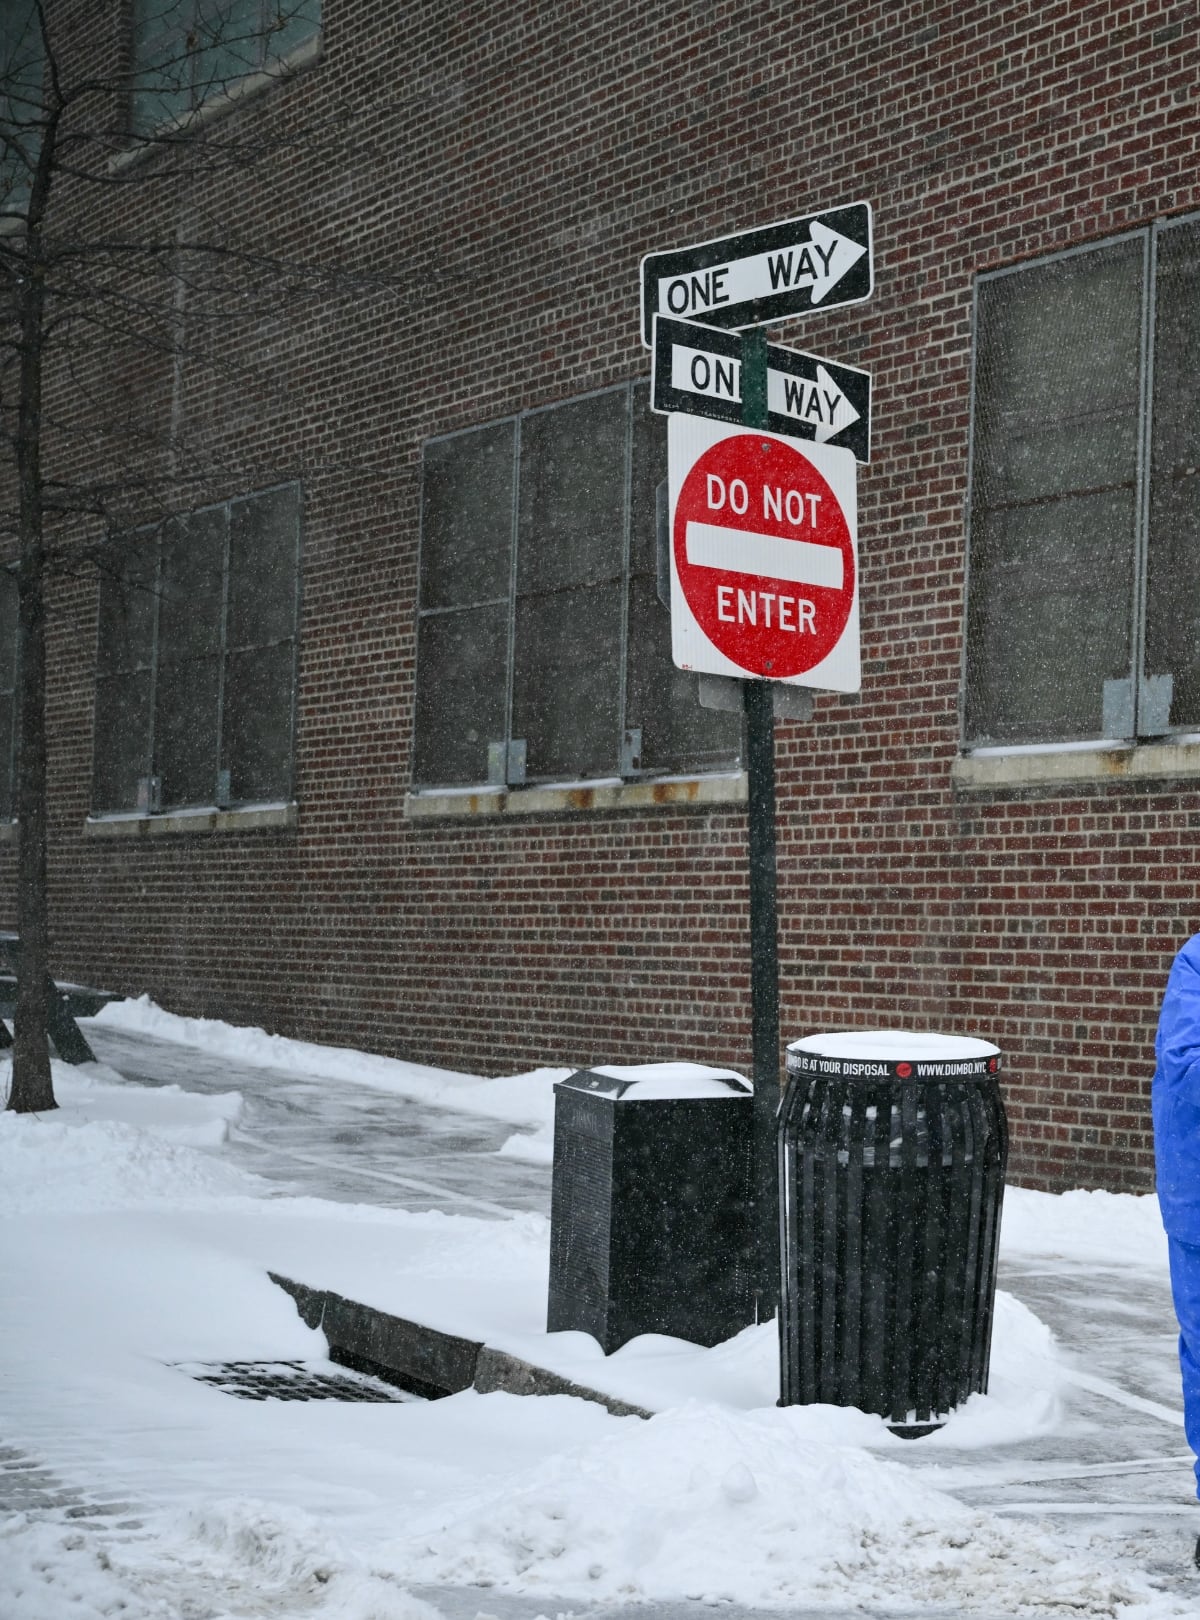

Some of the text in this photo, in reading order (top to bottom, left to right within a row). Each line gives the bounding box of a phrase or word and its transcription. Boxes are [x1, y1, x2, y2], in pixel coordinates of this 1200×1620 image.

[667, 240, 839, 315] ONE WAY
[690, 355, 842, 426] ON WAY
[706, 473, 822, 529] DO NOT
[717, 585, 817, 635] ENTER
[802, 1057, 809, 1070] IS
[809, 1060, 818, 1072] AT
[819, 1061, 841, 1074] YOUR
[842, 1063, 891, 1076] DISPOSAL
[917, 1061, 987, 1076] WWW.DUMBO.NYC
